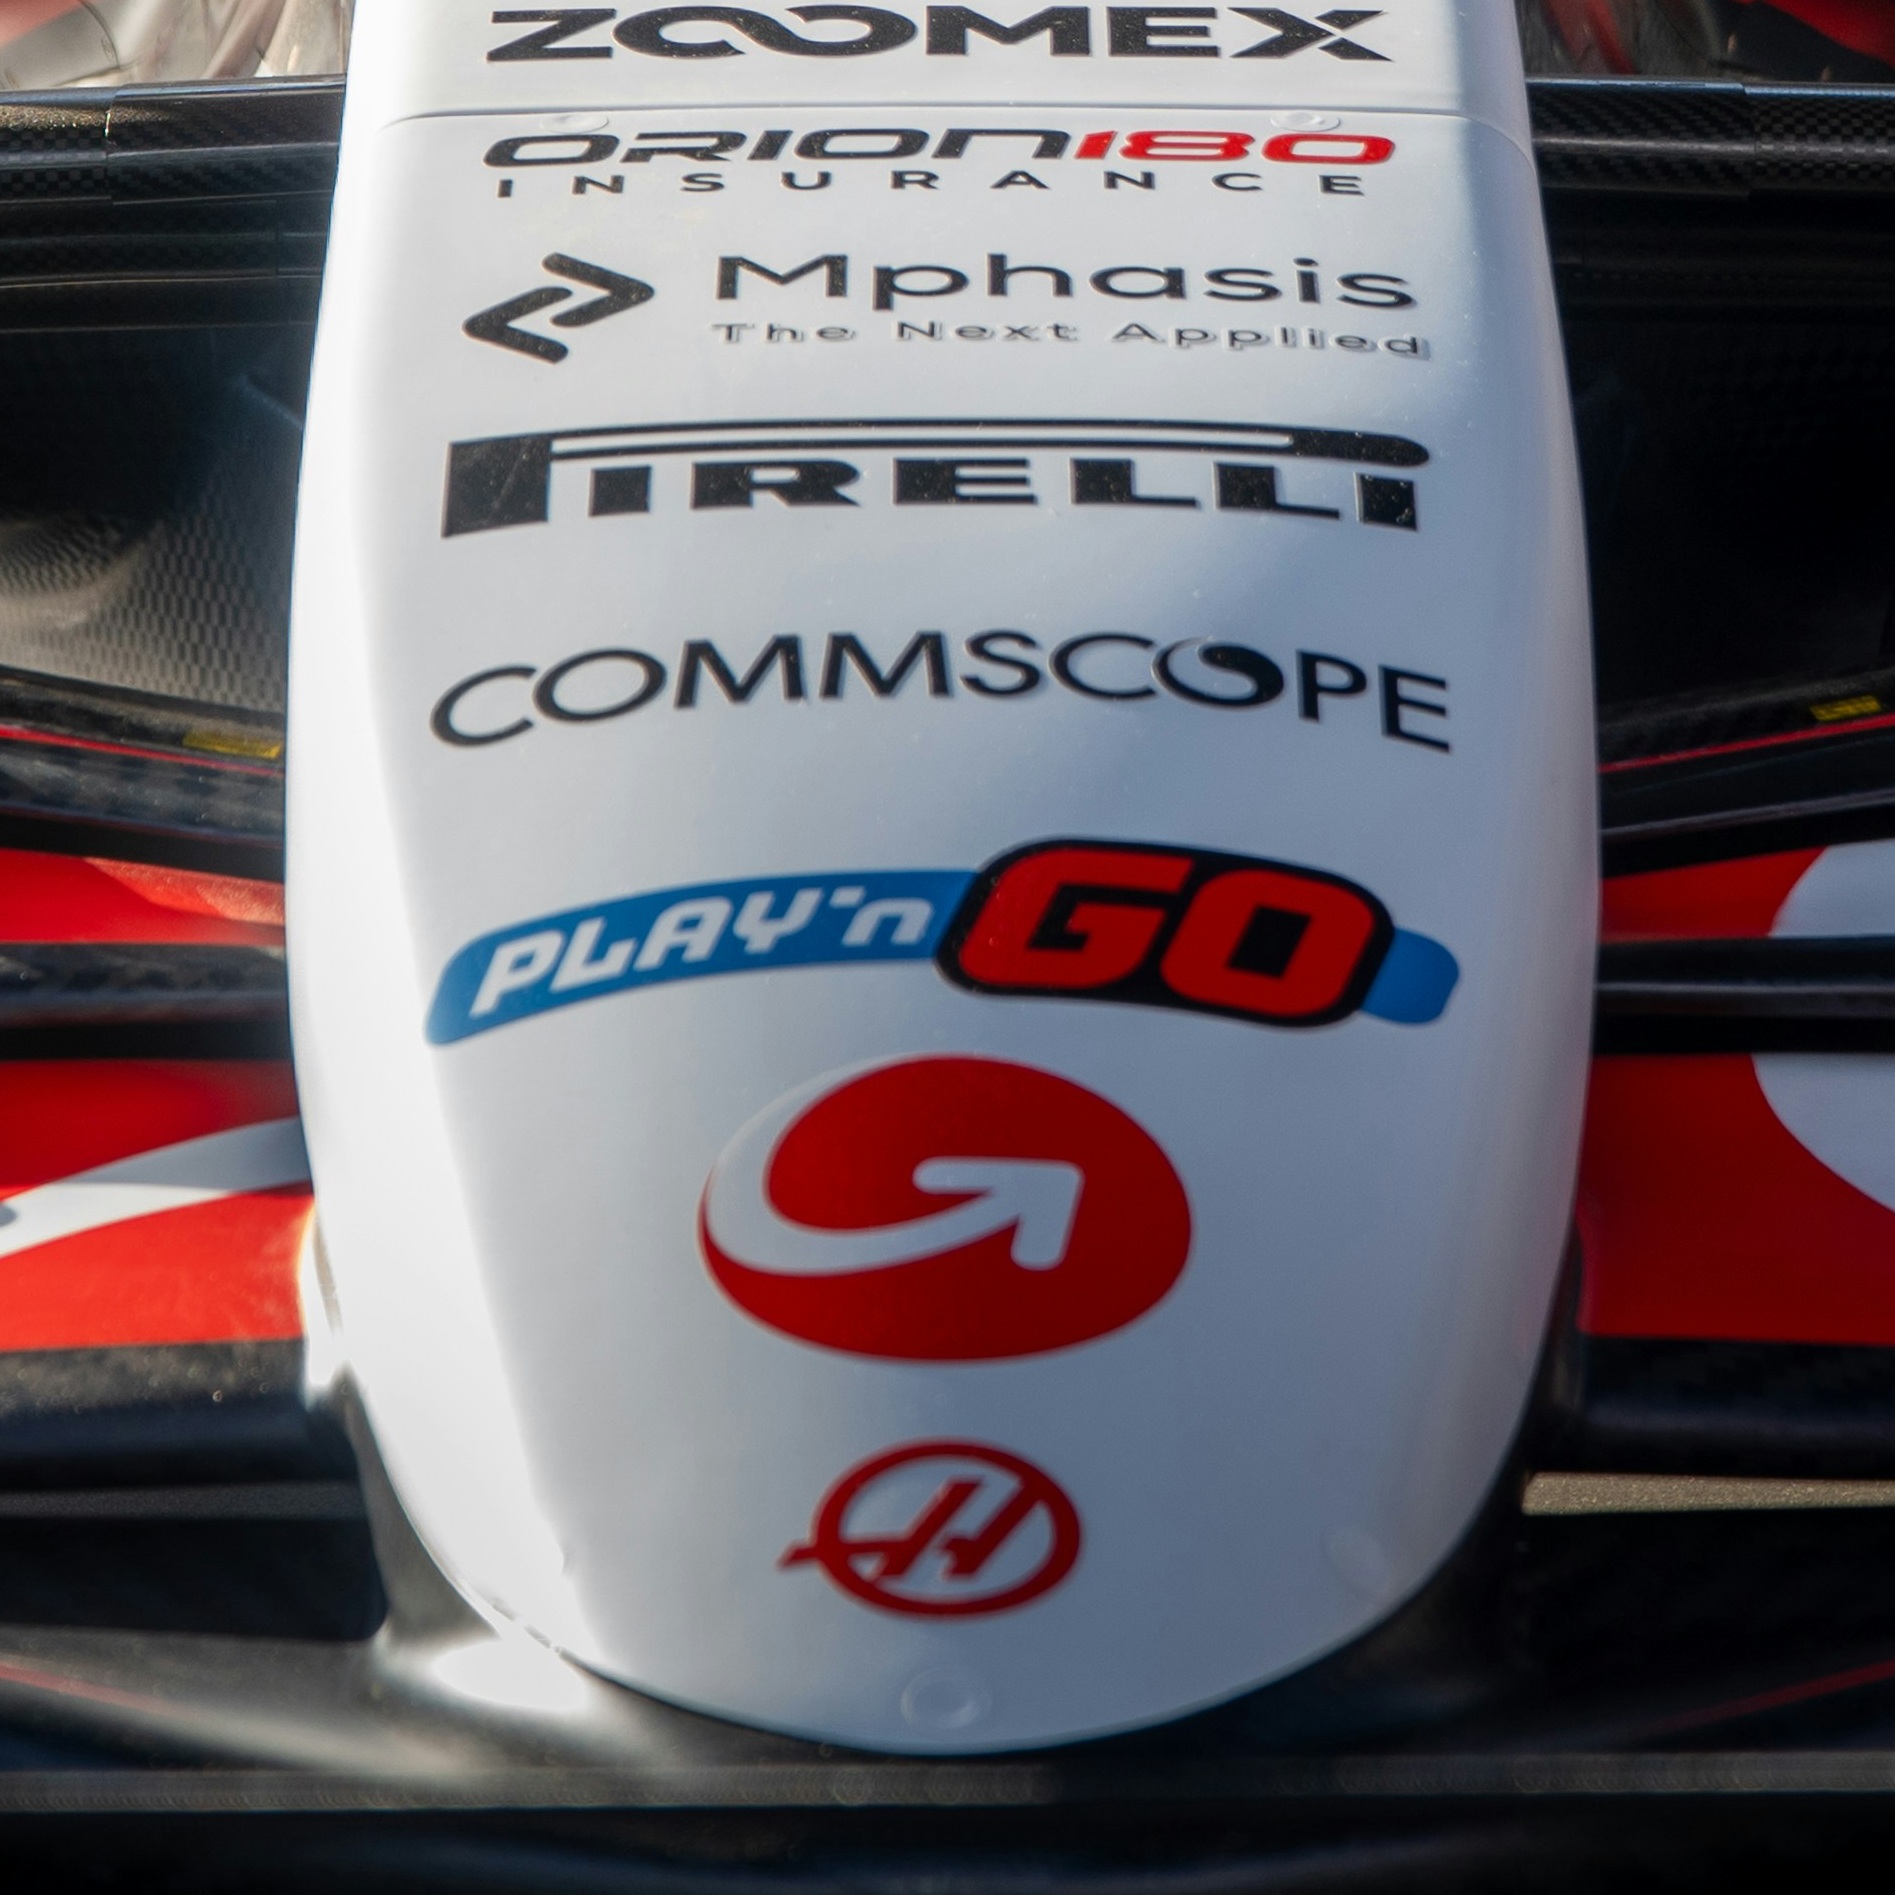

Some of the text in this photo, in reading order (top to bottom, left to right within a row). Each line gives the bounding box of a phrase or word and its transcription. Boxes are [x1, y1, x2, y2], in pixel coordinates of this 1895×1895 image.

[484, 4, 1394, 63] ZOOMEX
[483, 127, 1397, 164] ORION180
[497, 169, 1364, 197] INSURANCE
[716, 252, 1418, 310] Mphasis
[710, 320, 1432, 361] The Next Applied
[440, 418, 1431, 539] PIRELLI
[430, 629, 1453, 753] COMMSCOPE
[954, 846, 1376, 1020] GO
